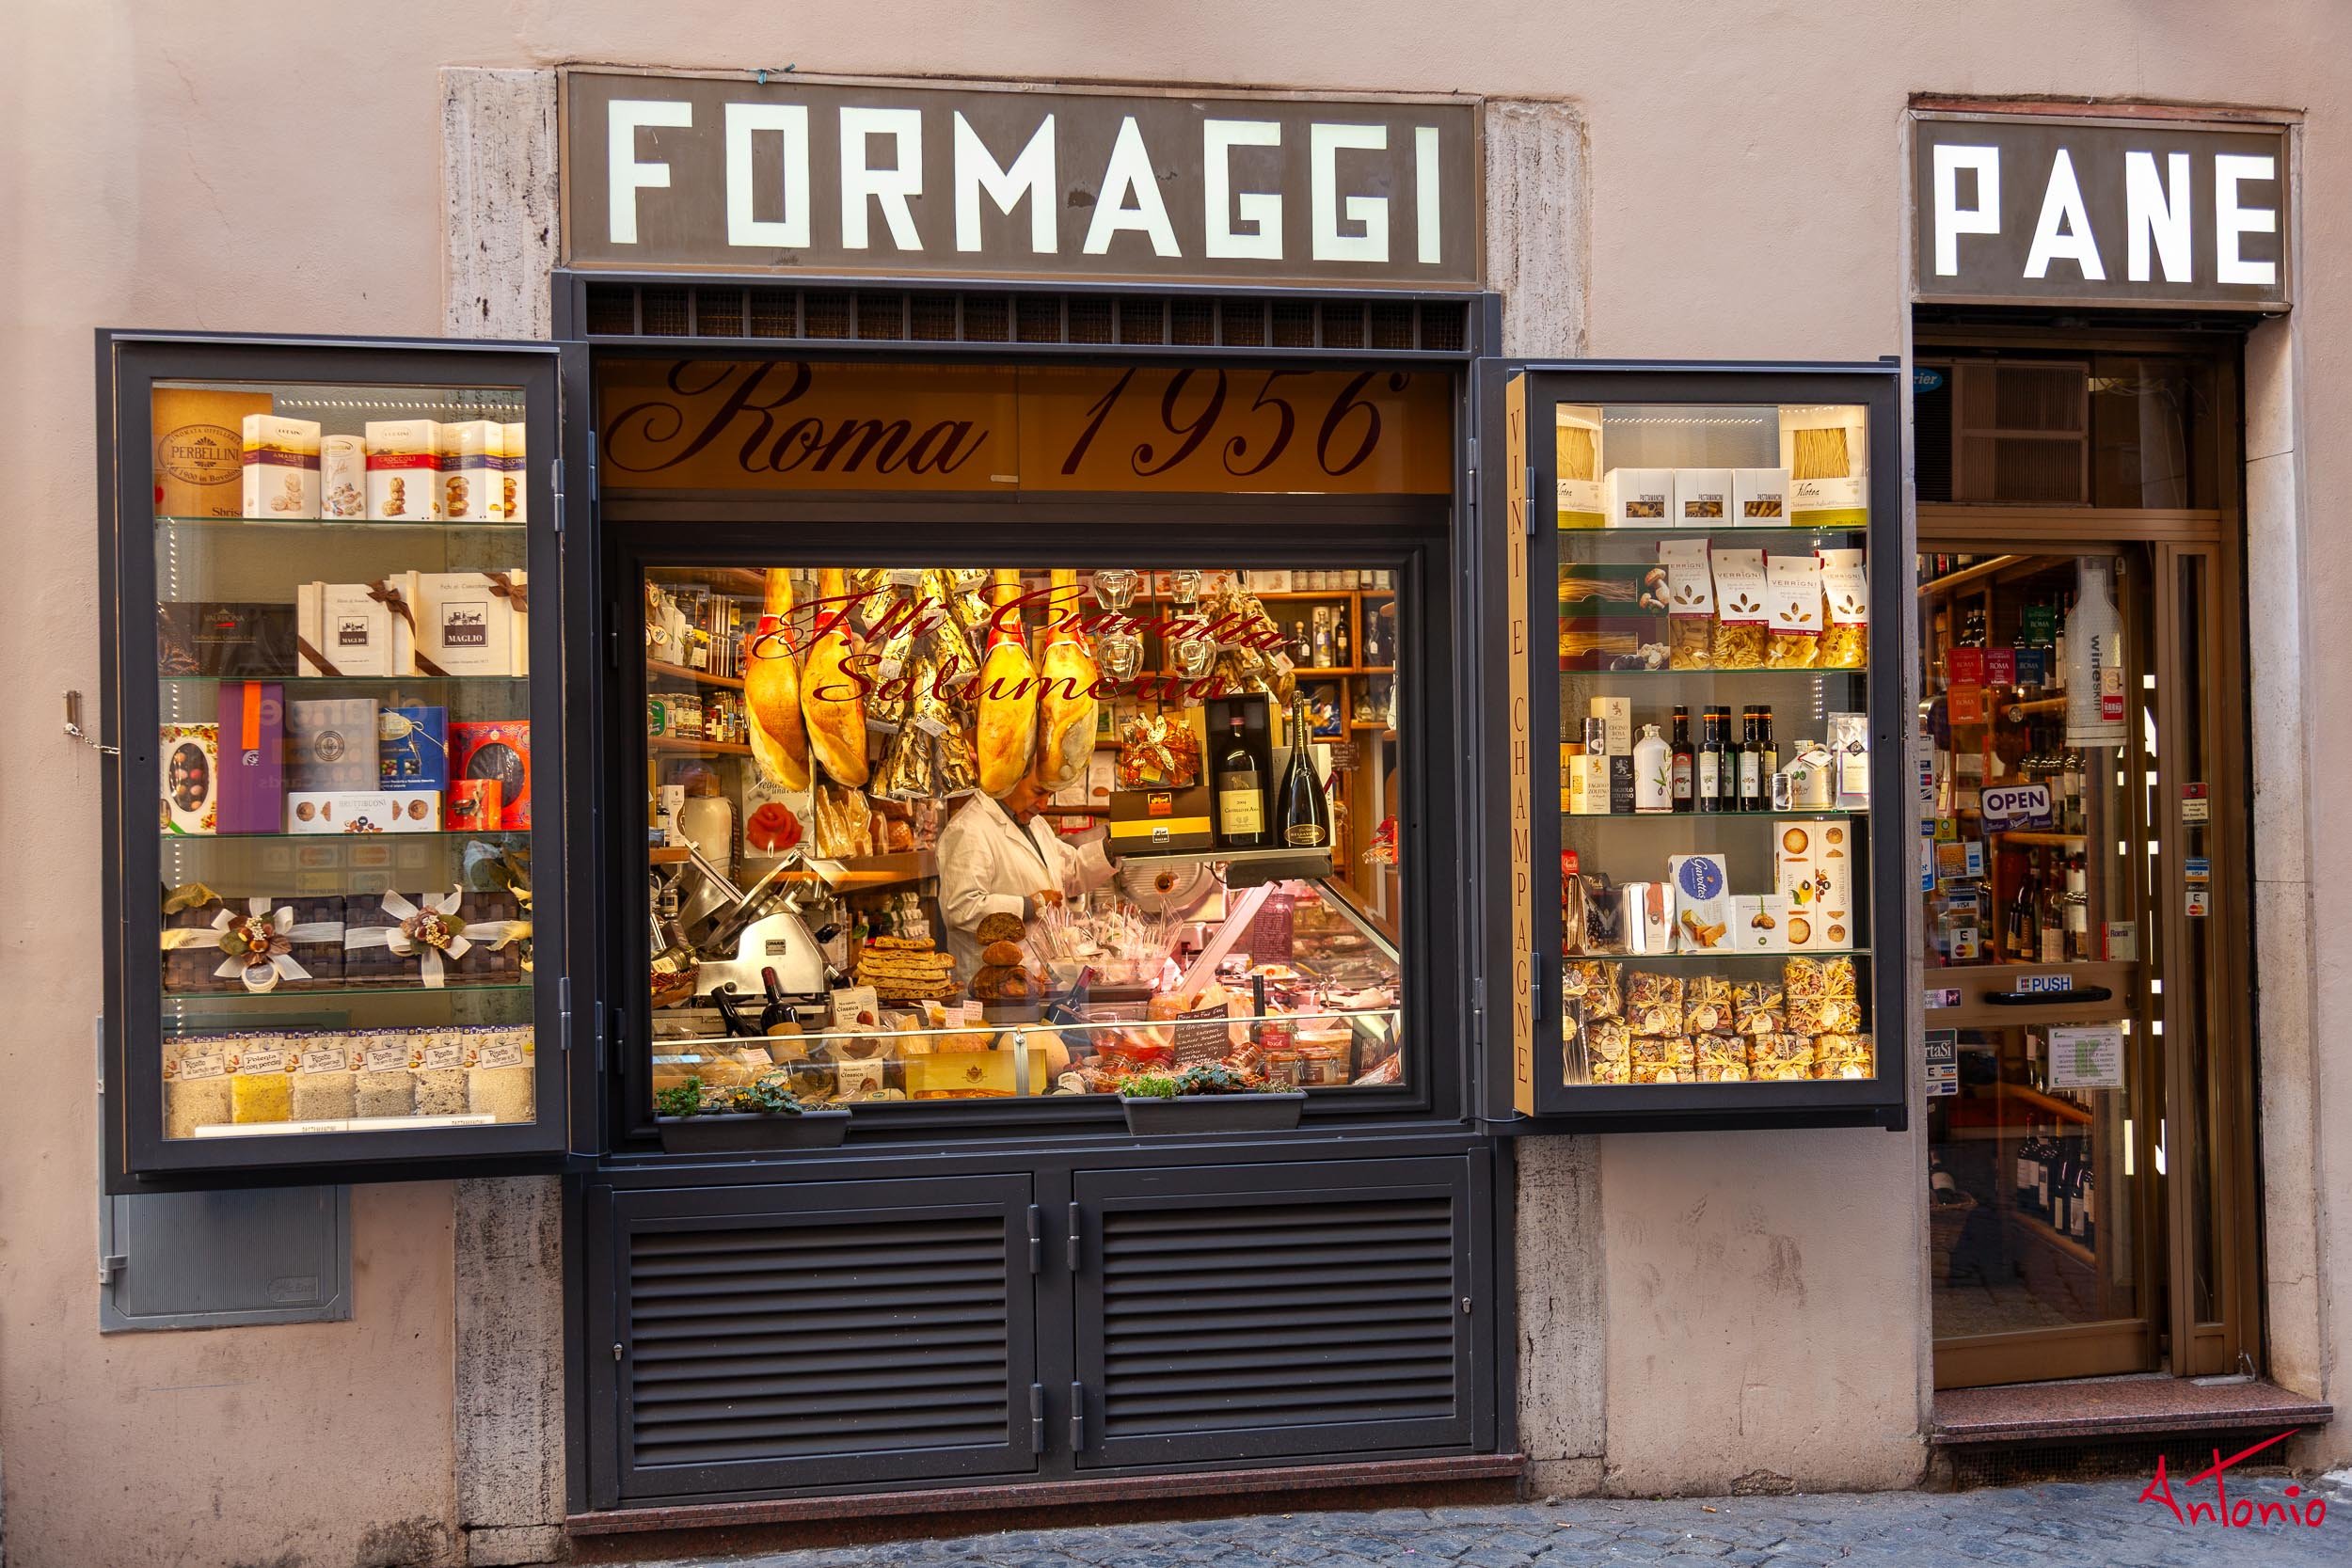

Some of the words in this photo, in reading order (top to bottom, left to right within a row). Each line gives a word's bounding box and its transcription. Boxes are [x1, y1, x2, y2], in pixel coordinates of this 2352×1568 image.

[609, 100, 1440, 263] FORMAGGI
[1933, 144, 2276, 284] PANE
[604, 360, 989, 475] Roma
[1061, 368, 1409, 476] 1956
[171, 446, 239, 461] PERBELLINI
[1510, 408, 1522, 578] VINI
[977, 583, 1295, 652] Ciavatta
[448, 635, 483, 643] MAGLIO
[1512, 619, 1523, 656] E
[813, 654, 1243, 703] Salumeria
[1987, 791, 2045, 811] OPEN
[1691, 857, 1708, 900] Gavottes
[1514, 697, 1529, 1084] CHAMPAGNE
[2110, 929, 2128, 938] Roma
[2032, 976, 2071, 992] PUSH
[246, 1053, 277, 1064] Polenta
[311, 1053, 331, 1064] Risotto
[373, 1053, 392, 1061] Risotto
[434, 1051, 453, 1059] Risotto
[489, 1049, 508, 1058] Risotto
[185, 1059, 206, 1069] Risotto
[259, 1060, 282, 1069] porcini
